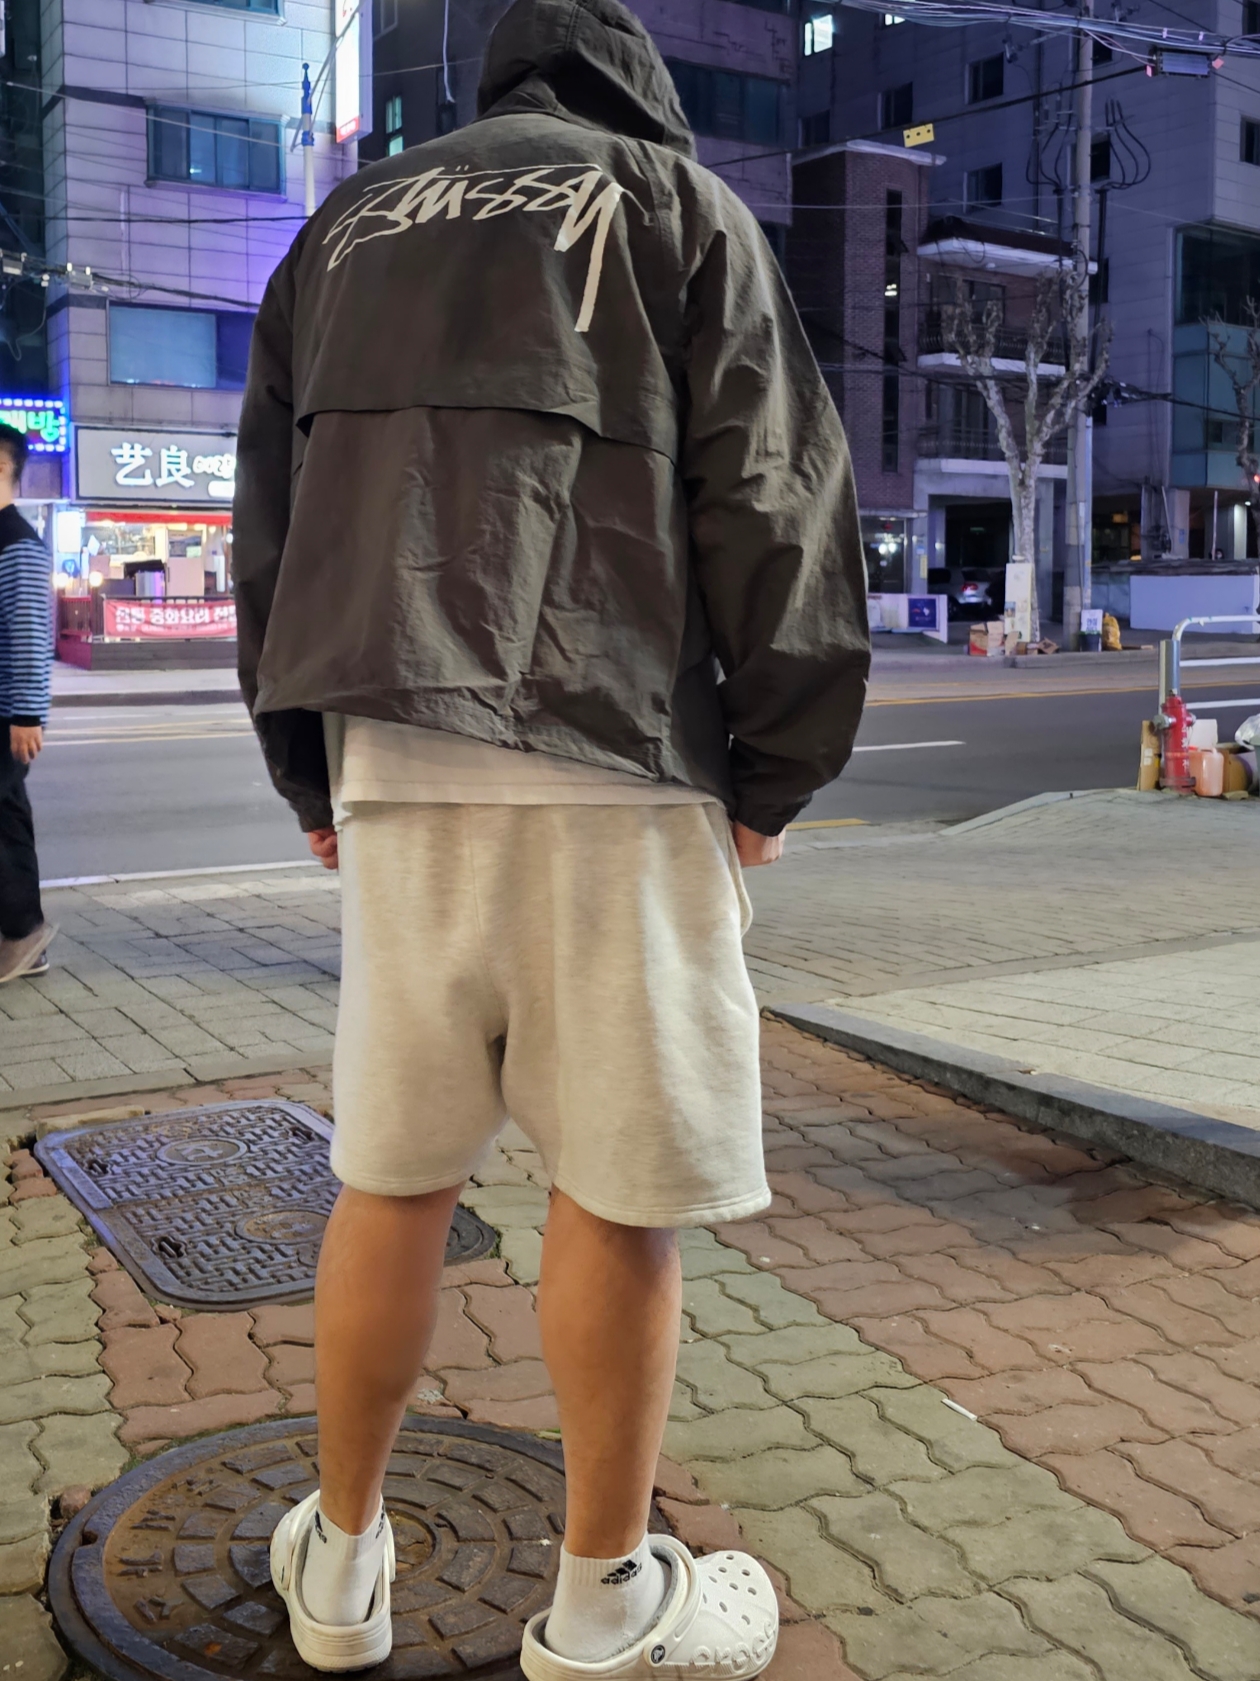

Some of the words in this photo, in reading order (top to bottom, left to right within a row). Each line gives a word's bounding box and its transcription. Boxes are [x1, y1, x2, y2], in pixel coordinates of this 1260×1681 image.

[110, 441, 195, 488] 艺良
[149, 606, 210, 625] 중화요리
[600, 1562, 643, 1585] adidas
